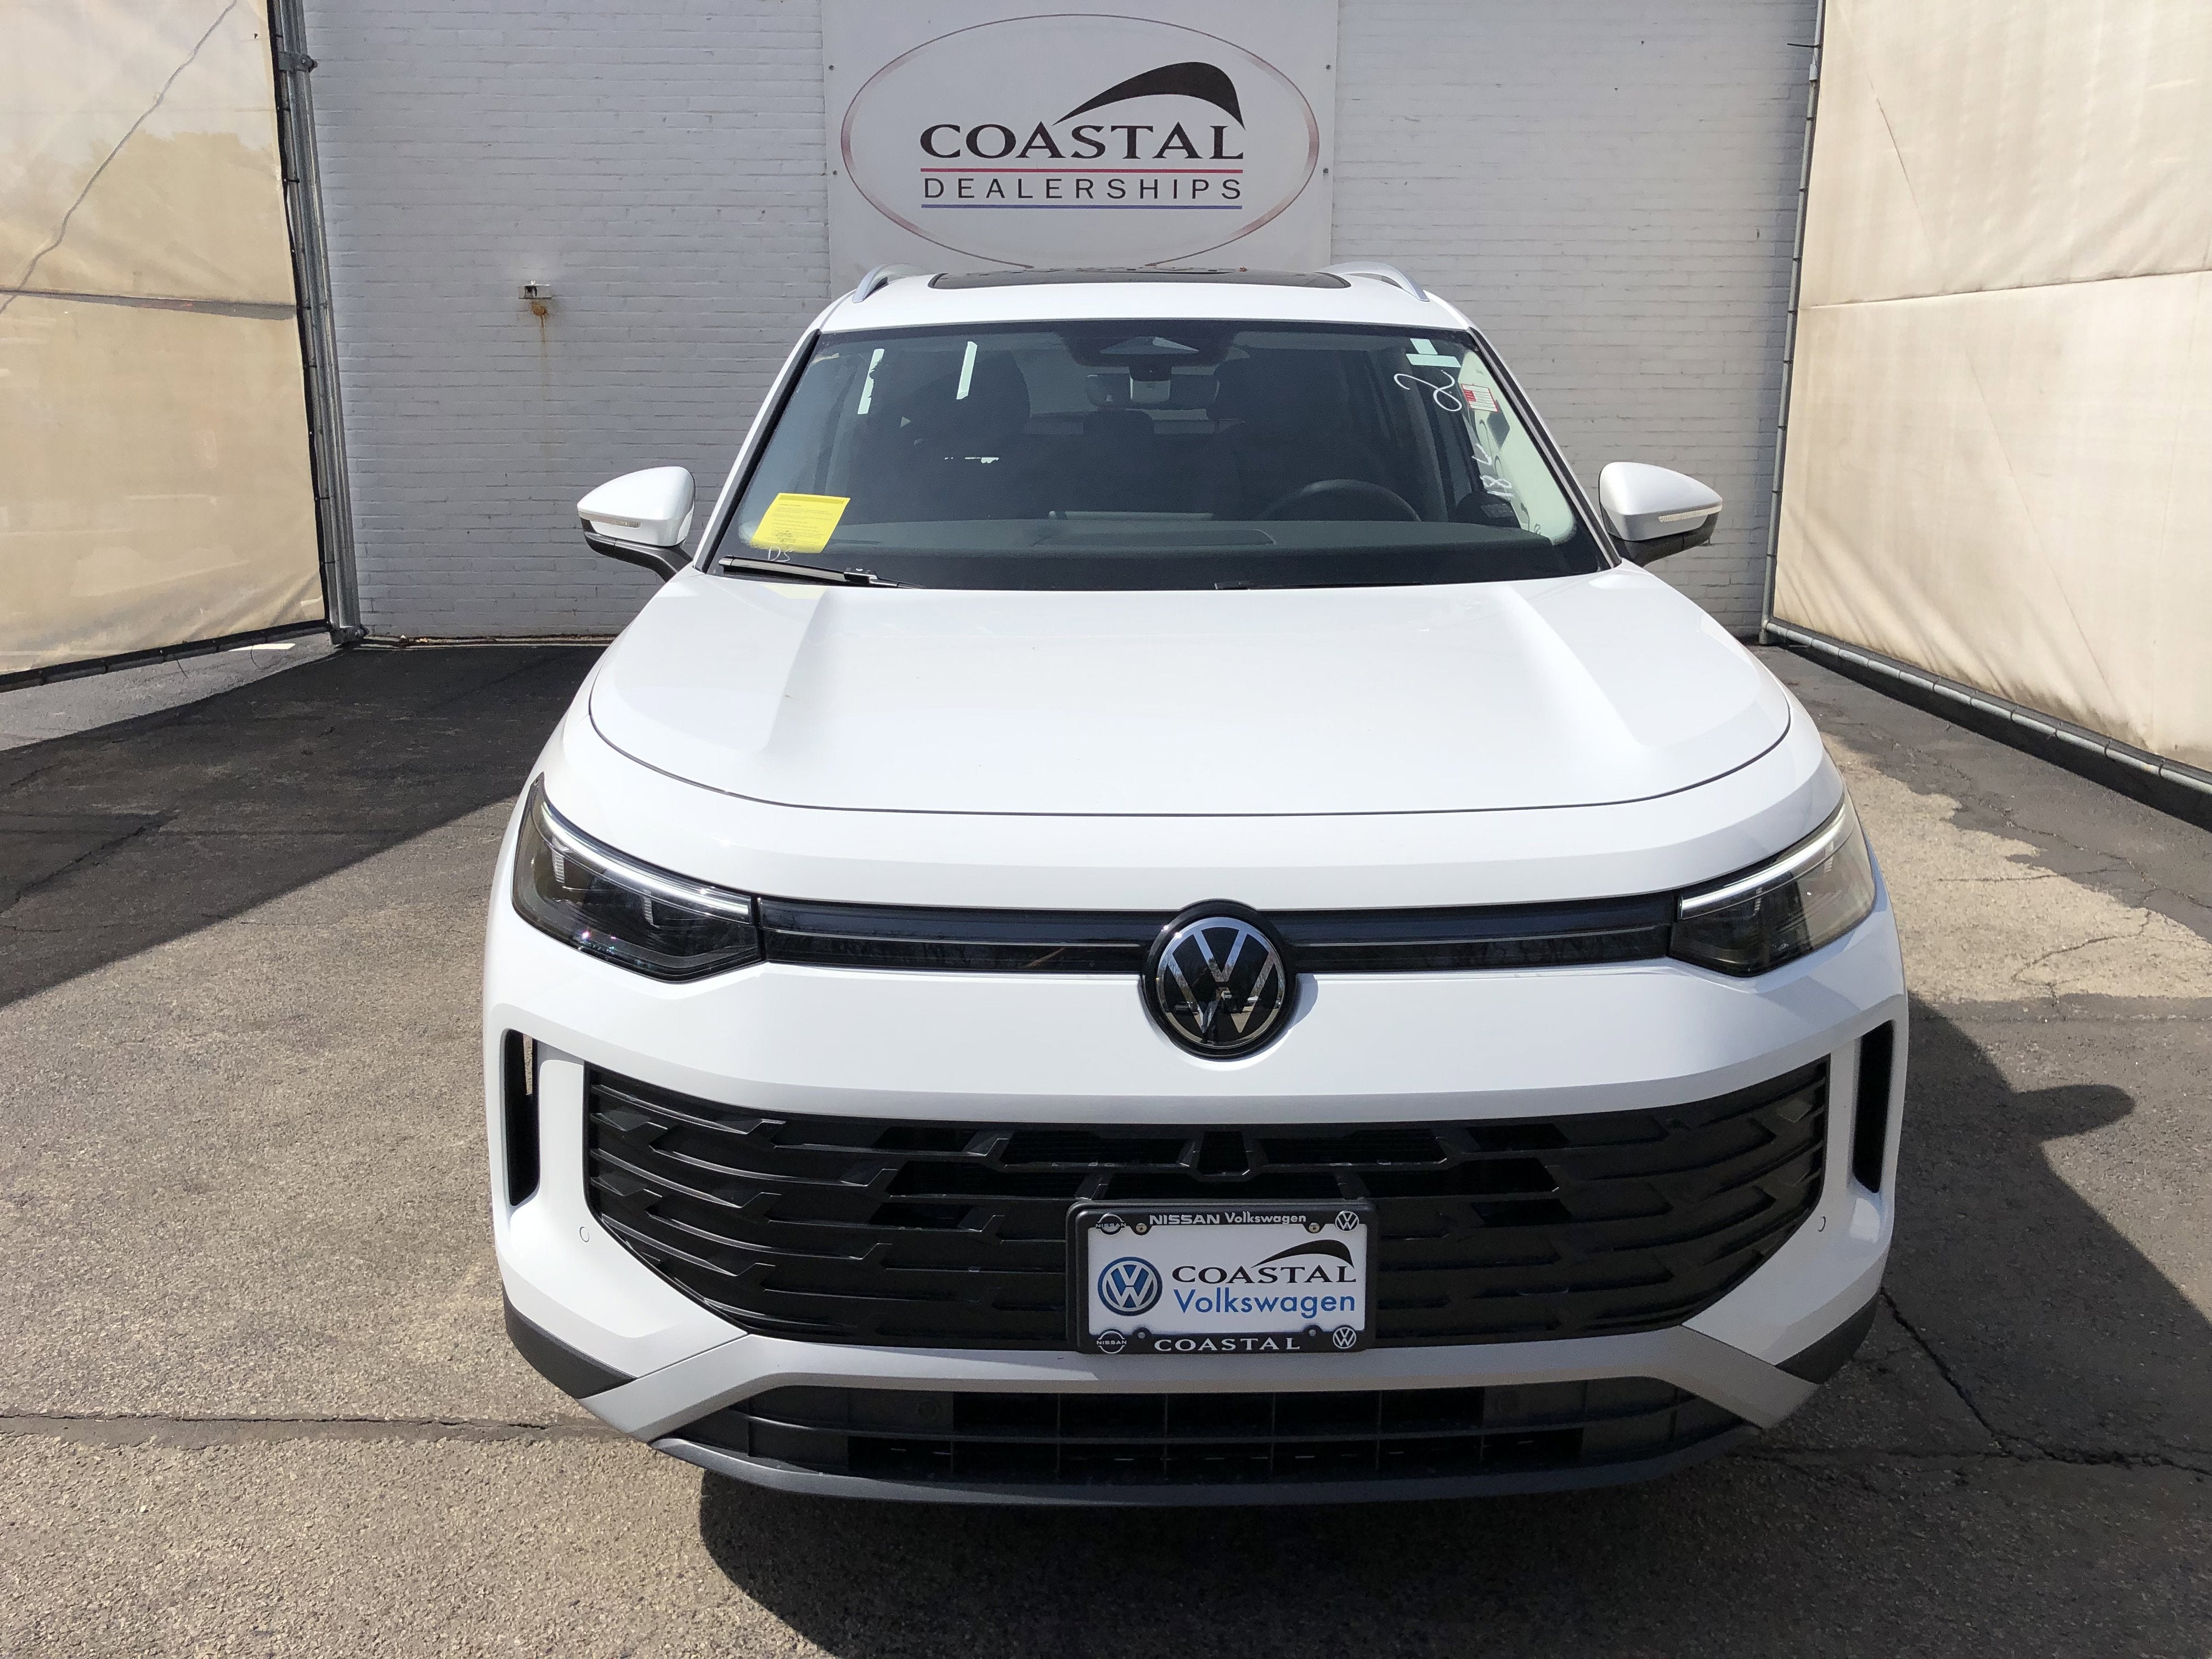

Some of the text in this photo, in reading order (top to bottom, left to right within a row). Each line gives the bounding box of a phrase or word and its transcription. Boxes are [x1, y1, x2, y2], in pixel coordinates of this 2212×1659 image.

[920, 121, 1244, 159] COASTAL
[924, 178, 1242, 200] DEALERSHIPS
[1150, 1211, 1306, 1224] NISSAN Volkswagen
[1172, 1265, 1356, 1284] COASTAL
[1173, 1287, 1355, 1319] Volkswagen
[1155, 1338, 1300, 1351] COASTAL
